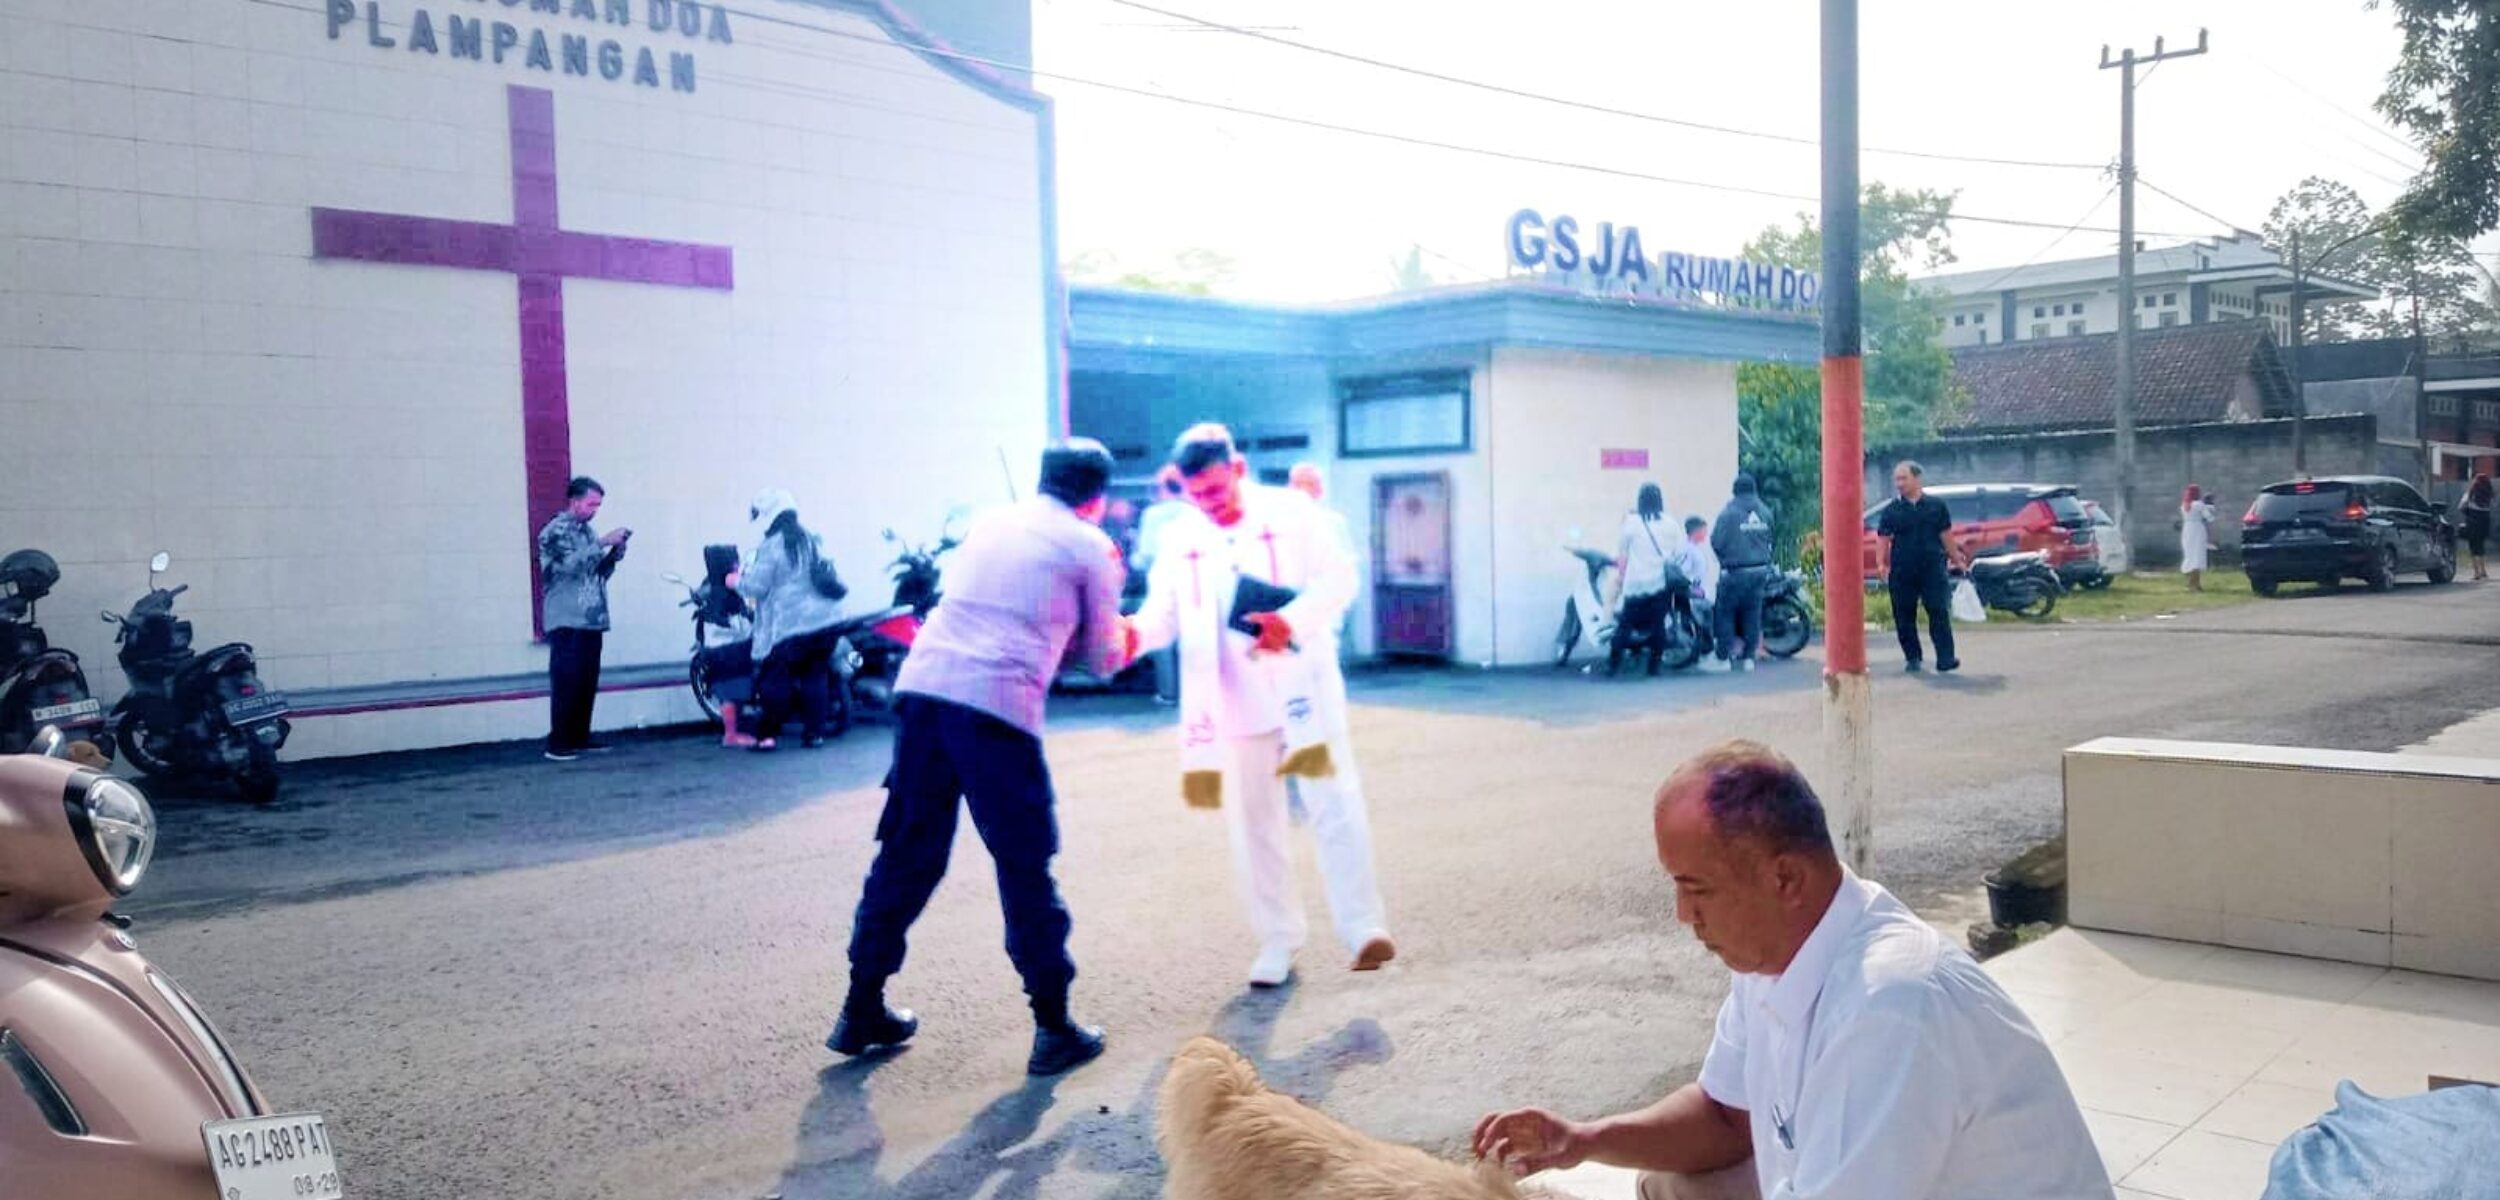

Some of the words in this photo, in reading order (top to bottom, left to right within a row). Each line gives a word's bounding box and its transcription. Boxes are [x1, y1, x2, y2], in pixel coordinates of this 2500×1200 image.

[326, 0, 697, 94] PLAMPANGAN
[649, 0, 734, 45] DOA
[1506, 207, 1648, 283] GSJA
[1662, 251, 1774, 300] RUMAH
[1780, 267, 1824, 306] DO
[216, 1132, 246, 1169] AG
[244, 1126, 295, 1168] 2488
[293, 1122, 331, 1159] PAT
